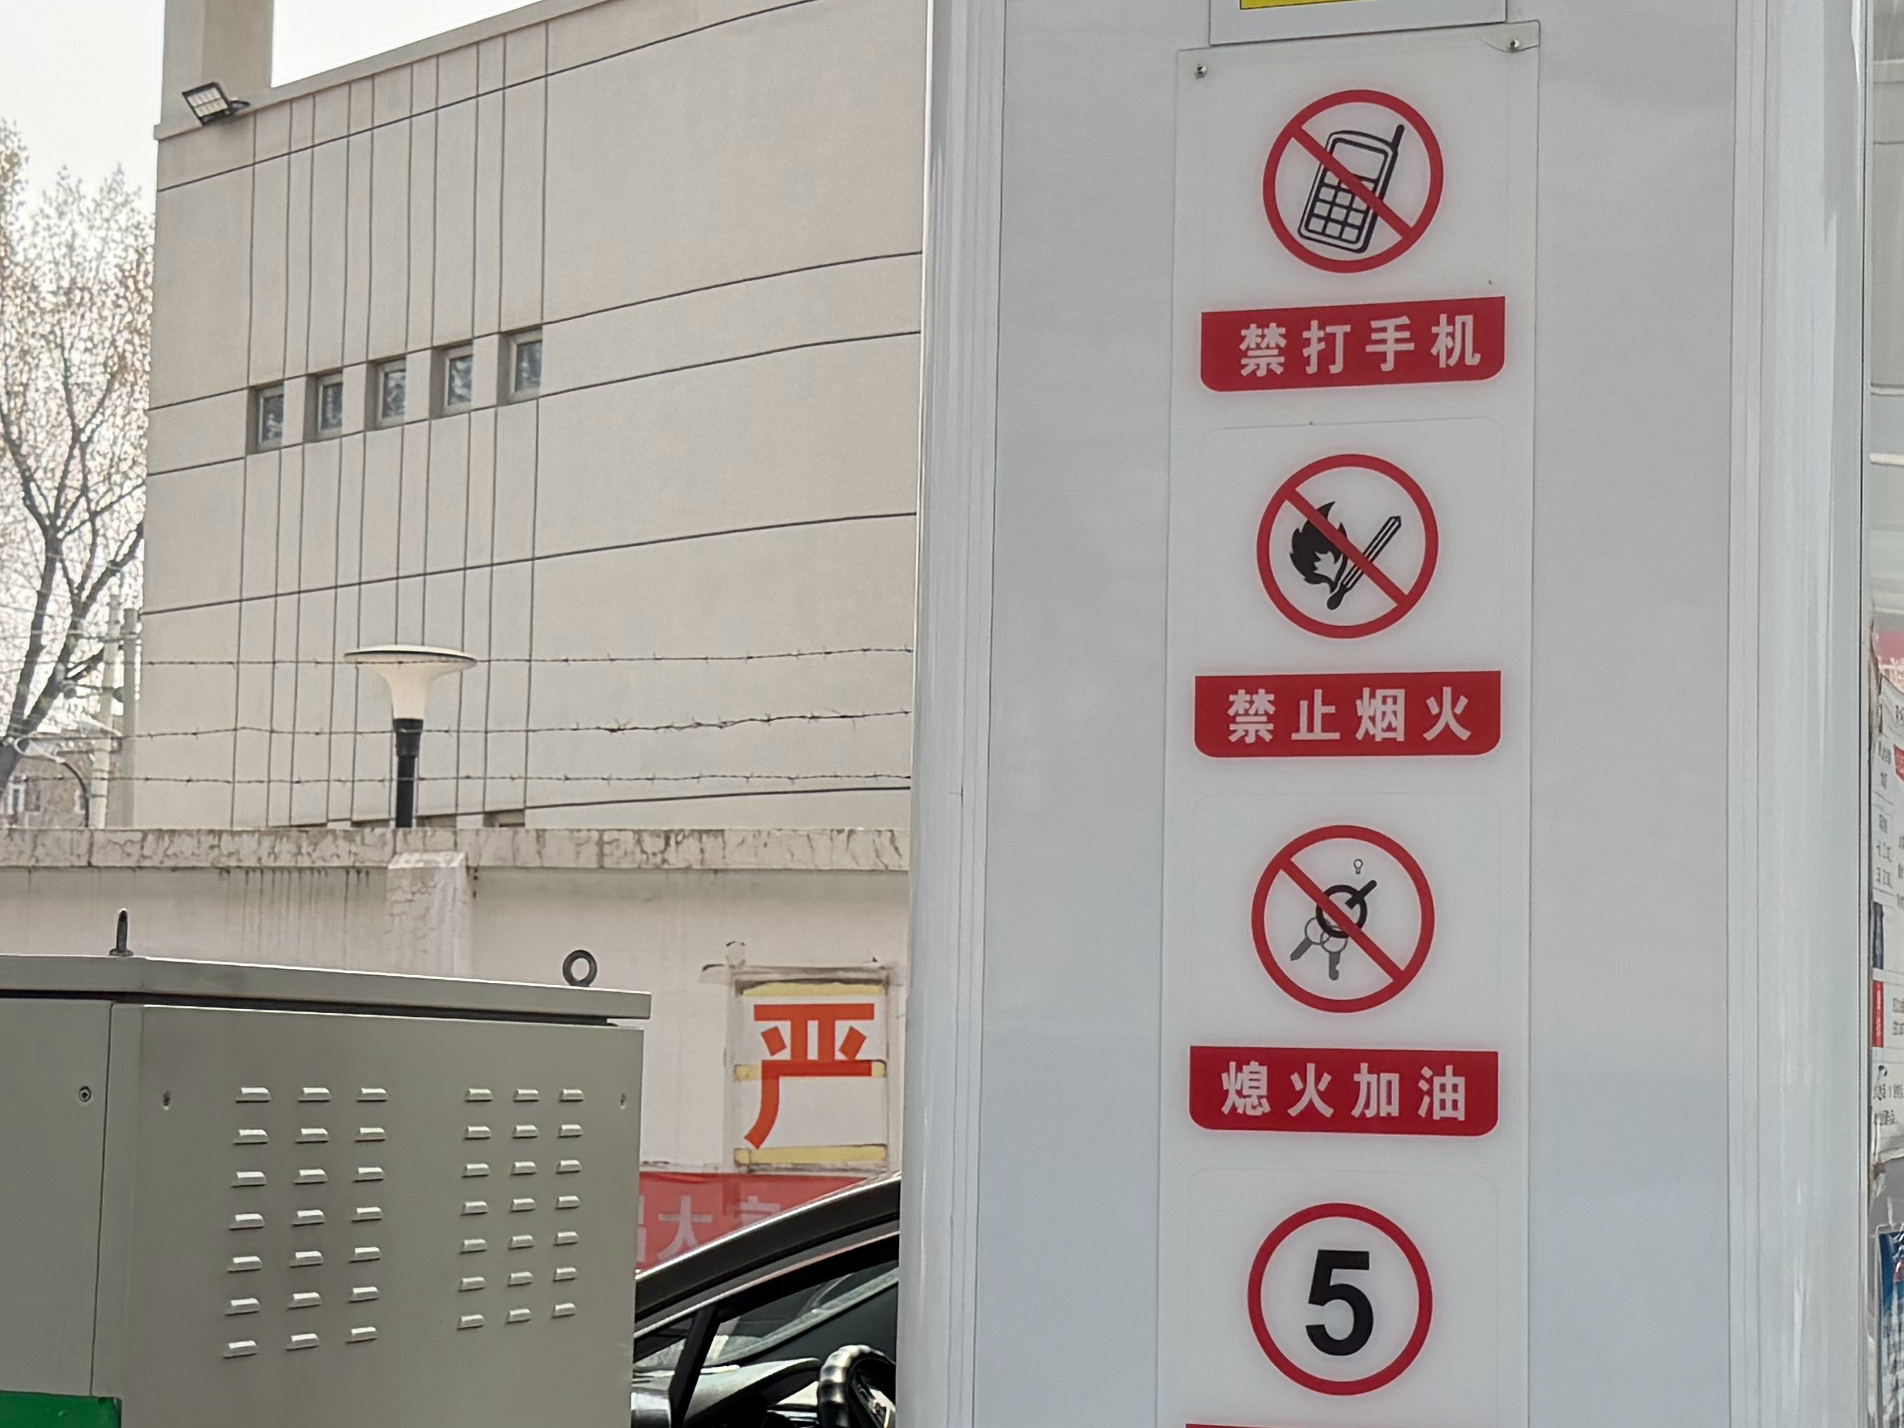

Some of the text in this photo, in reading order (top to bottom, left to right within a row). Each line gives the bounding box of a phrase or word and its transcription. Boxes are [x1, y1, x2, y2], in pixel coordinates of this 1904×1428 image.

[1239, 313, 1482, 379] 禁打手机
[1227, 687, 1471, 744] 禁止烟火
[744, 1003, 875, 1149] 严
[1221, 1060, 1466, 1121] 熄火加油
[1304, 1249, 1374, 1356] 5
